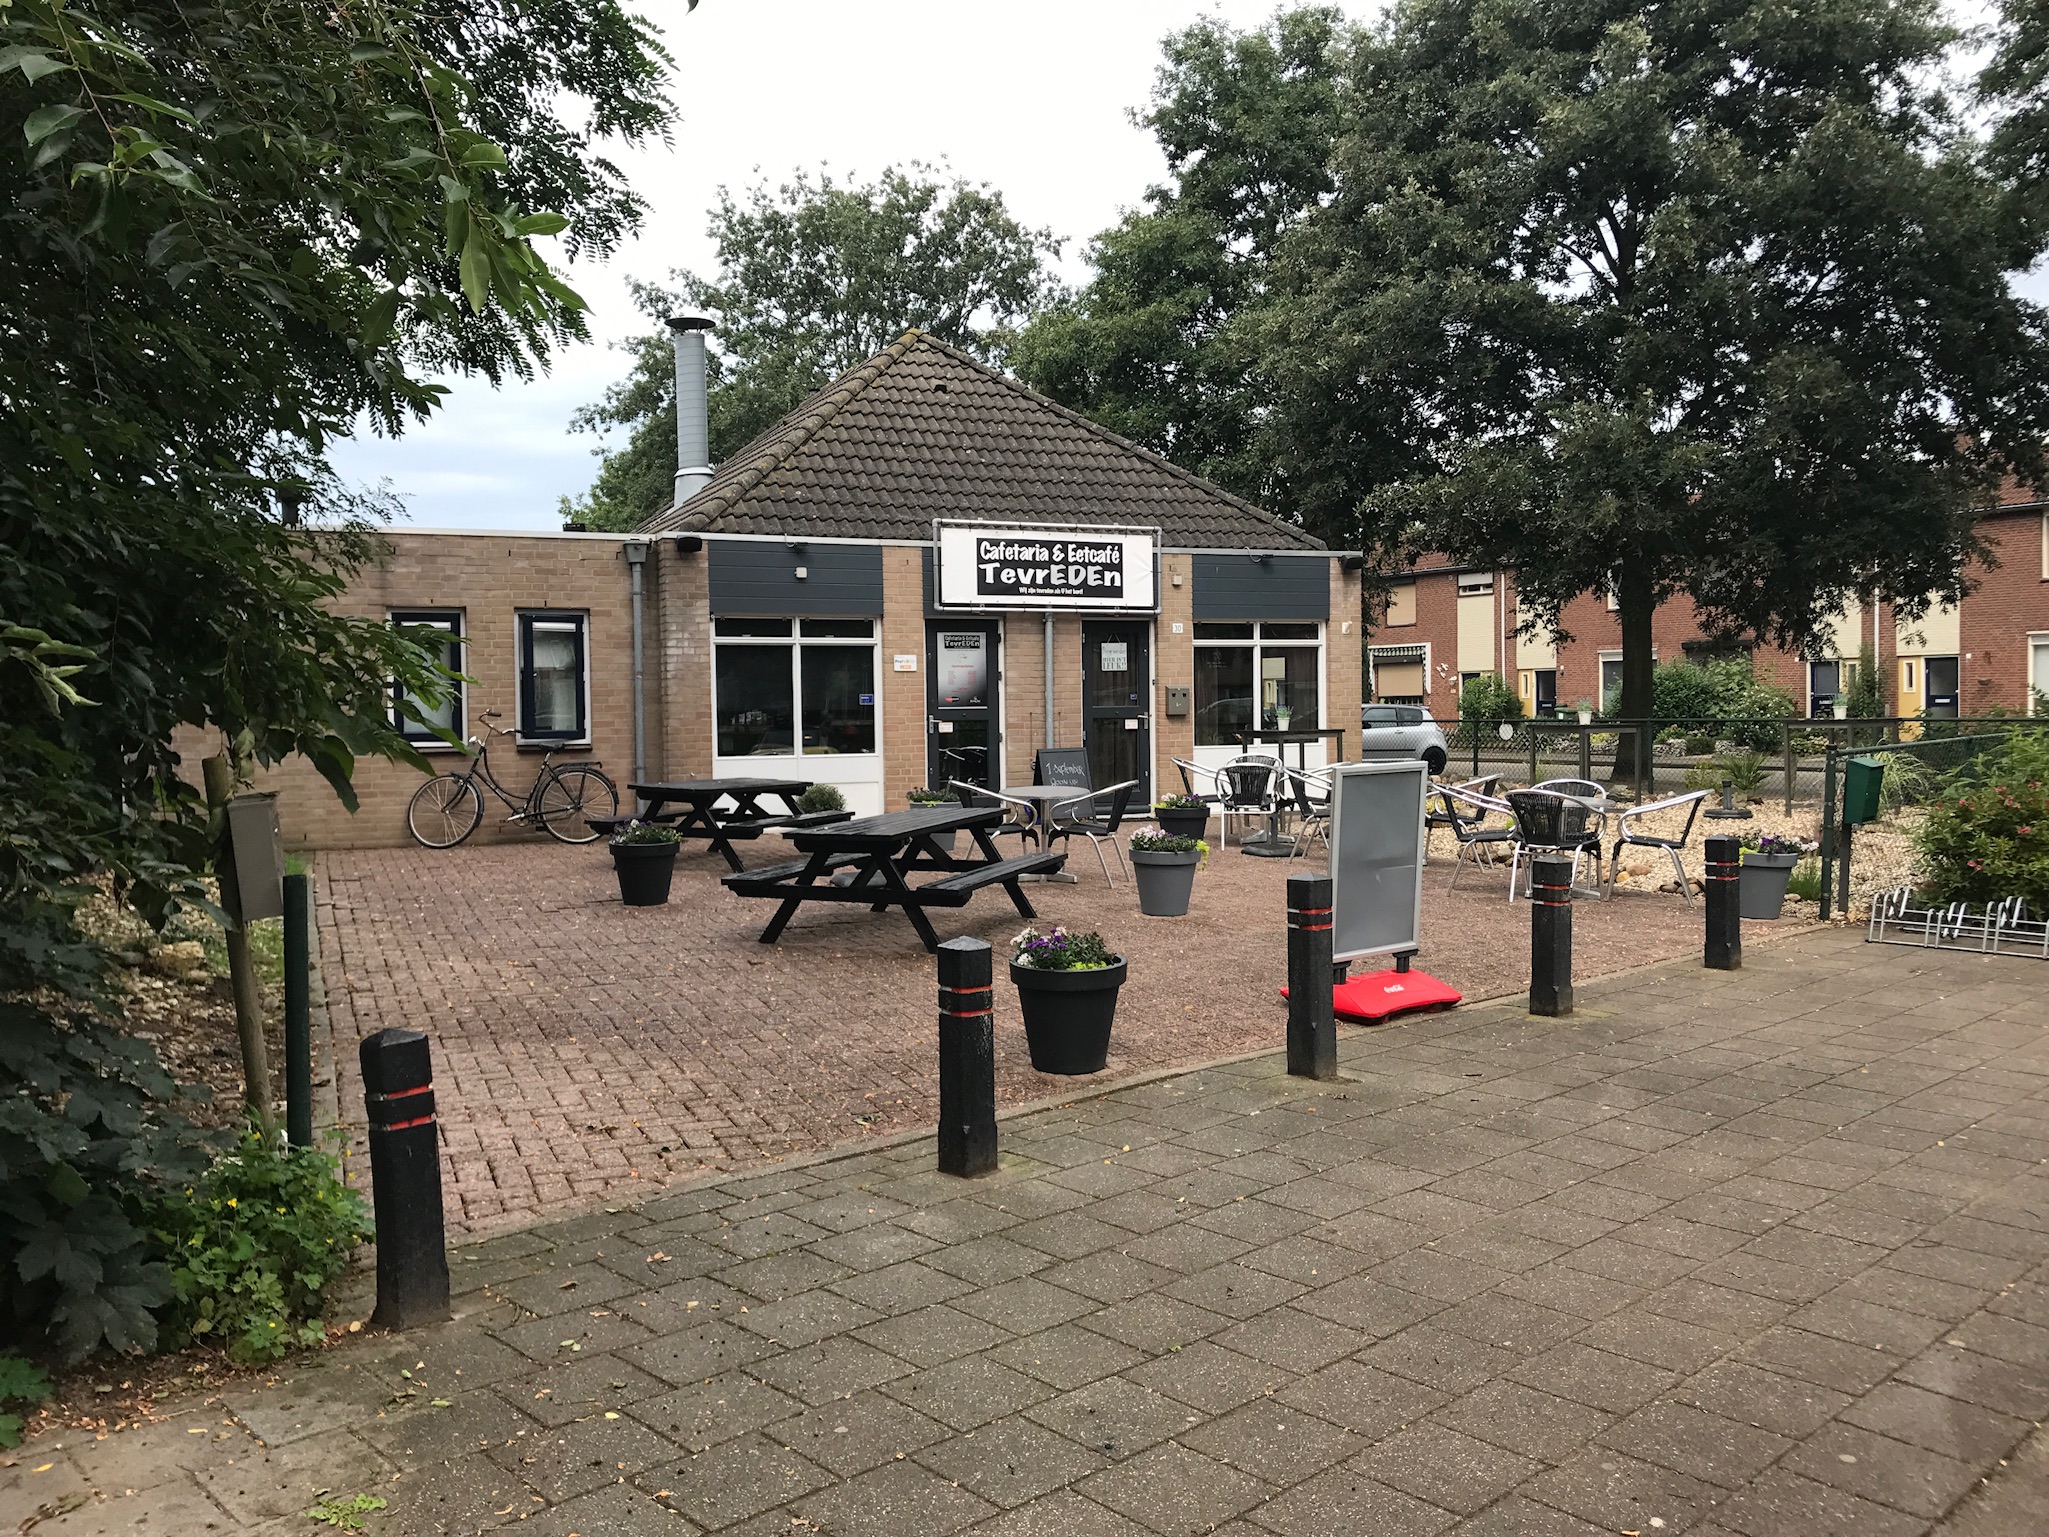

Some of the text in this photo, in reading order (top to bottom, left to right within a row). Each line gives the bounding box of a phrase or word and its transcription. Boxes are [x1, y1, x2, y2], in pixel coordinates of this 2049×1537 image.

[980, 541, 1120, 564] Cafetaria & Eetcafé
[978, 562, 1121, 587] TevrEDEn
[1174, 624, 1181, 632] 30
